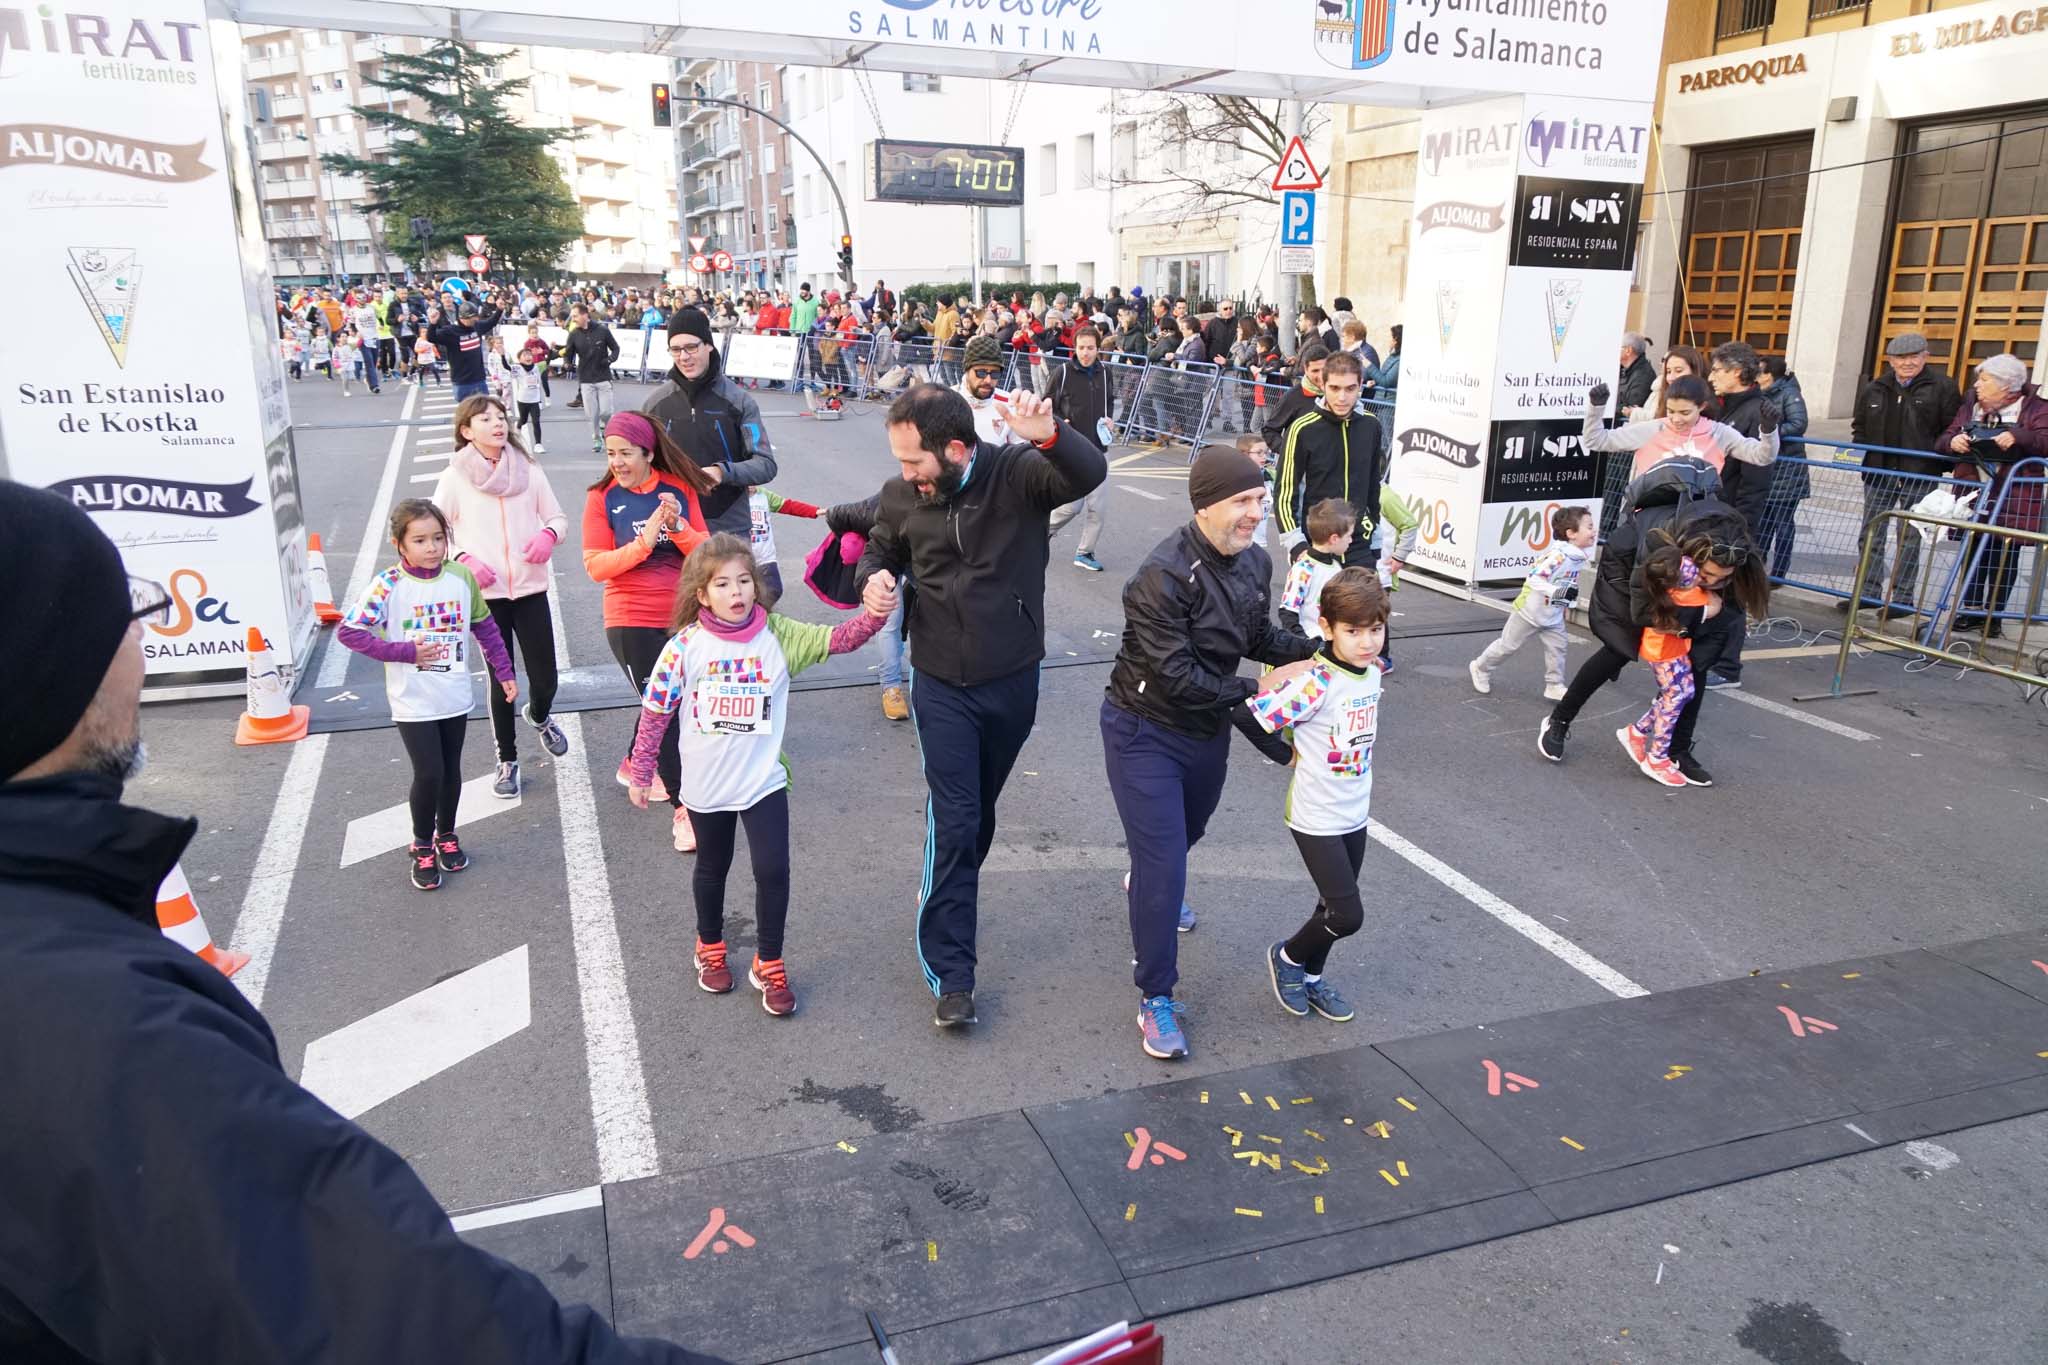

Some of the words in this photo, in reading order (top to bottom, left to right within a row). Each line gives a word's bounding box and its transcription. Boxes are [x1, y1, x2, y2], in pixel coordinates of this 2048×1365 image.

[1406, 0, 1607, 25] yuntamiento
[849, 11, 1101, 53] SALMANTINA
[1404, 21, 1439, 55] de
[1453, 27, 1602, 70] Salamanca
[1888, 31, 1925, 58] EL
[83, 60, 197, 85] fertilizantes
[1679, 52, 1808, 93] PARROQUIA
[9, 131, 177, 176] ALJOMAR
[1583, 154, 1638, 169] fertilizantes
[1431, 206, 1491, 229] ALJOMAR
[1528, 235, 1580, 248] RESIDENCIAL
[1585, 238, 1618, 250] ESPAÑA
[1504, 372, 1529, 387] San
[1535, 372, 1601, 387] Estanislao
[19, 383, 72, 405] San
[83, 383, 225, 404] Estanislao
[1518, 393, 1533, 407] de
[1538, 393, 1584, 407] Kostka
[58, 412, 91, 433] de
[100, 411, 199, 433] Kostka
[161, 434, 236, 446] Salamanca
[1411, 432, 1467, 464] ALJOMAR
[1501, 472, 1552, 484] RESIDENCIAL
[1556, 470, 1588, 481] ESPAÑA
[72, 482, 229, 512] ALJOMAR
[144, 638, 274, 659] SALAMANA
[720, 685, 766, 694] SETEL
[708, 696, 754, 717] 7600
[720, 722, 749, 732] ALJOMAR
[1347, 705, 1375, 731] 7517
